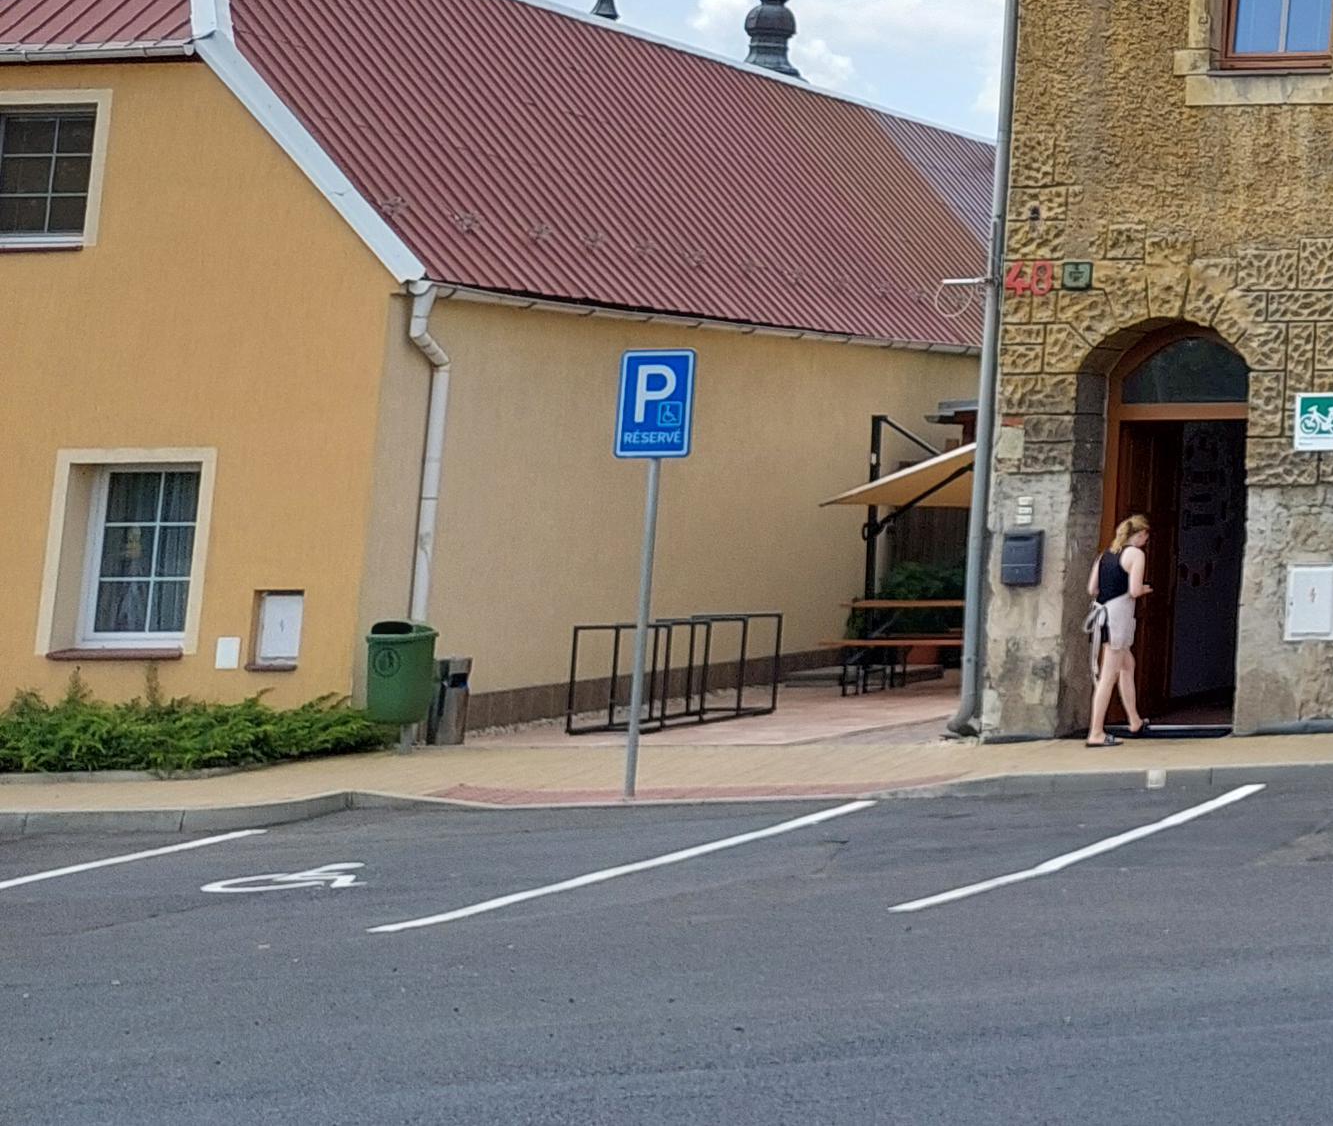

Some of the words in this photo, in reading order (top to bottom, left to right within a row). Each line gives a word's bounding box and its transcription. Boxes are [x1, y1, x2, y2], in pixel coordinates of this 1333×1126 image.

[1006, 260, 1053, 296] 48
[634, 364, 677, 423] P
[623, 429, 682, 444] RÉSERVÉ
